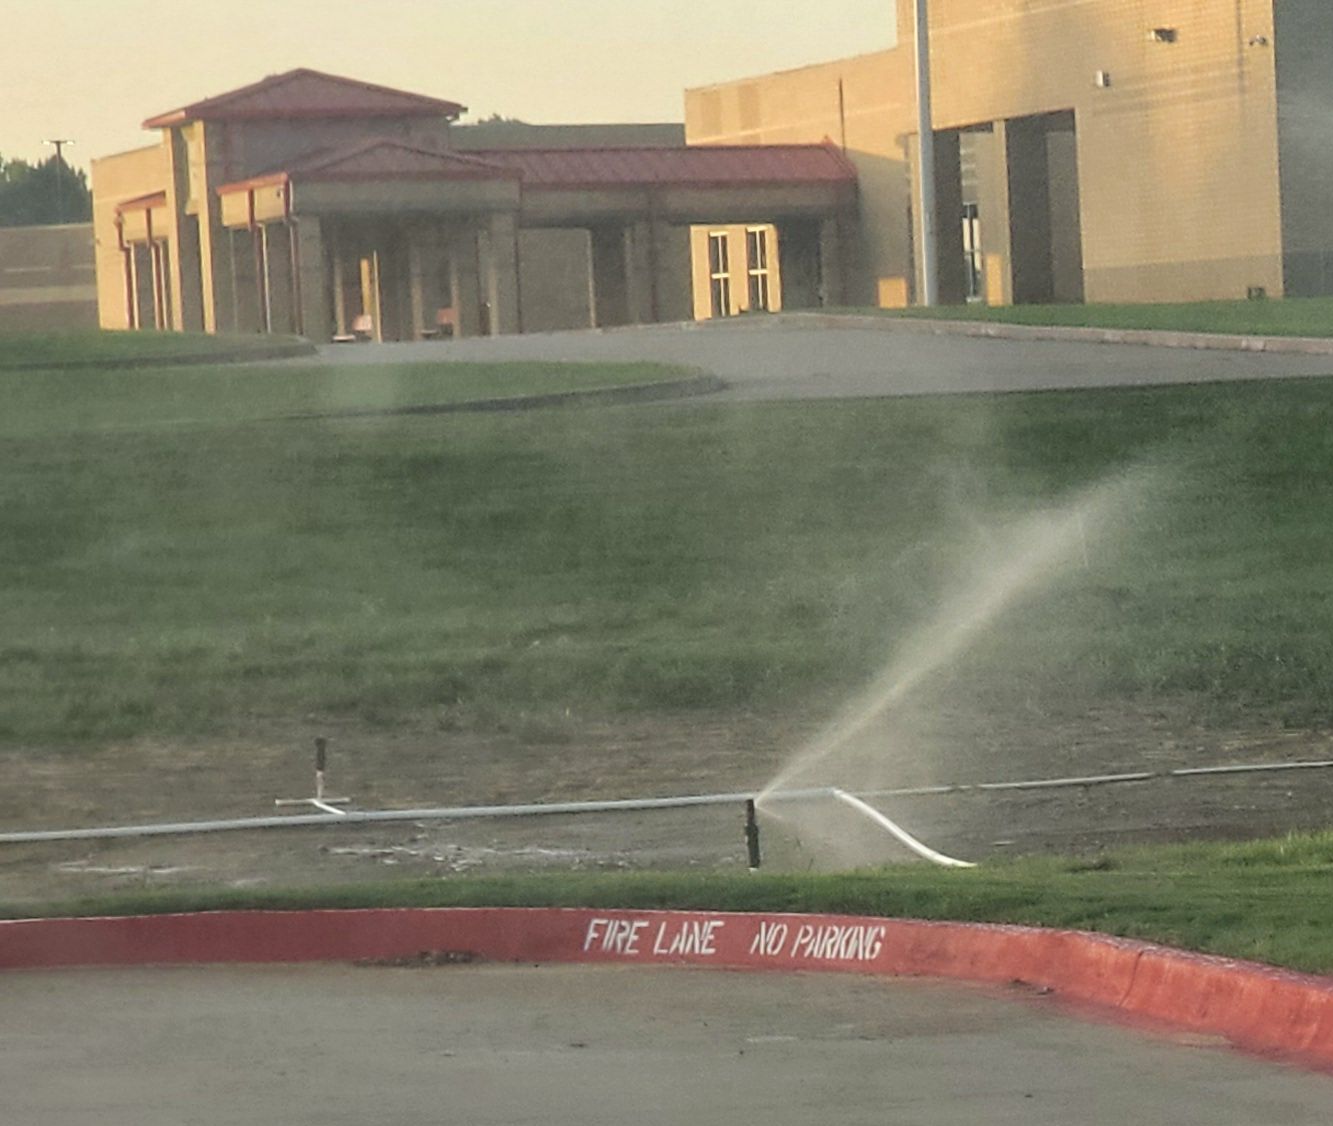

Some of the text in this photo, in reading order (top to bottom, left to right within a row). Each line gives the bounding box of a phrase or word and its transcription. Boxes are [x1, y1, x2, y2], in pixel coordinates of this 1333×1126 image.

[584, 918, 886, 960] FIRE LANE NO PARKING
